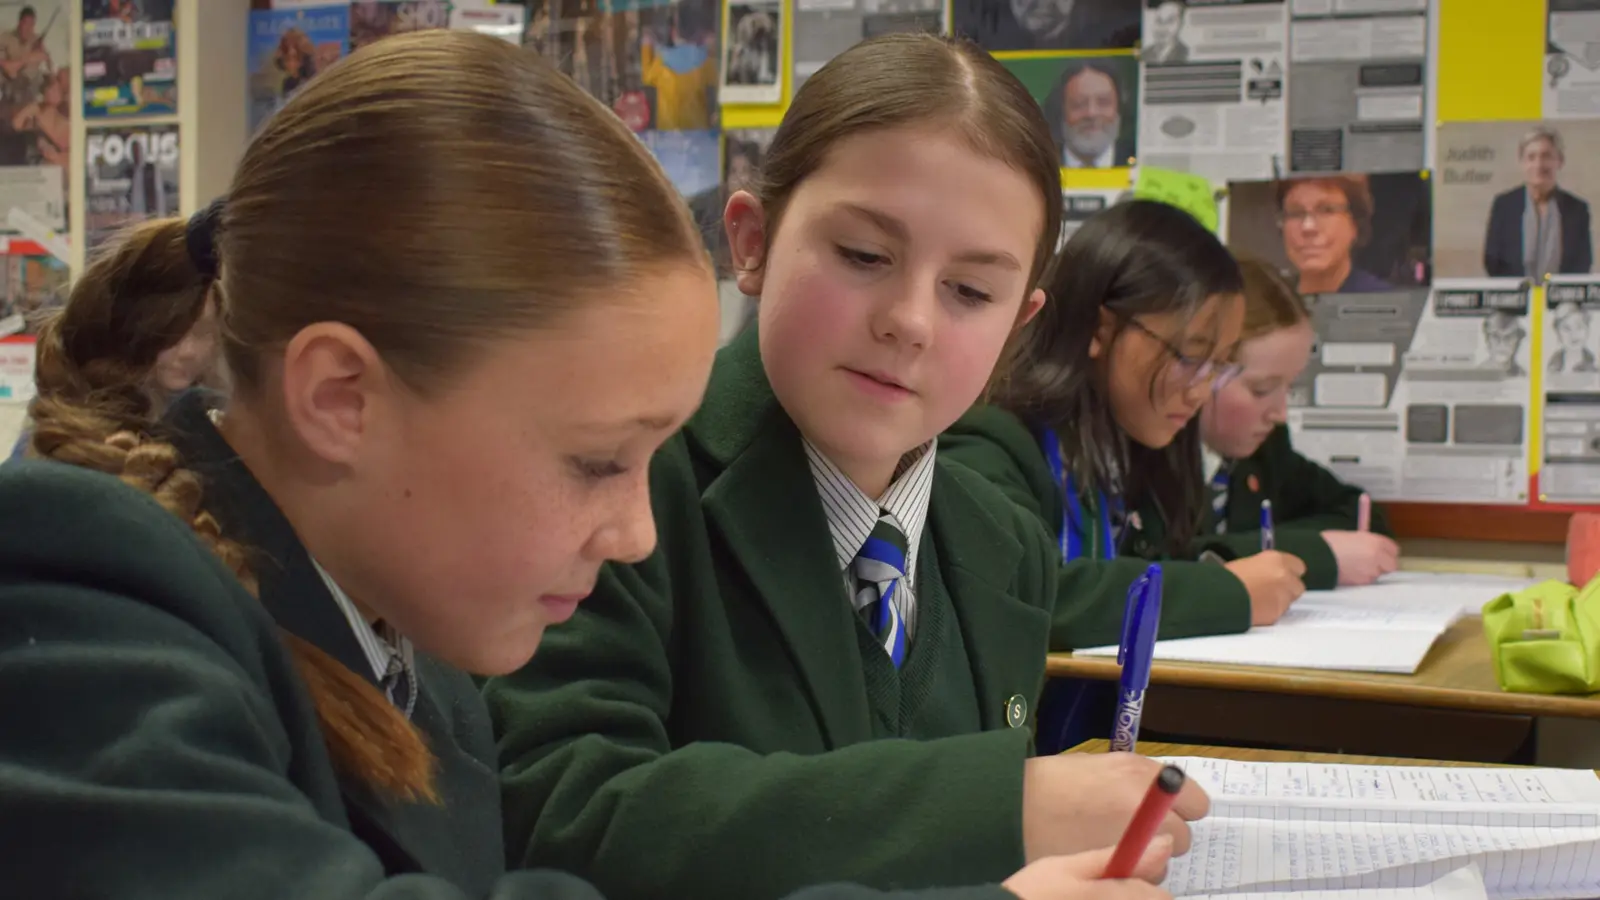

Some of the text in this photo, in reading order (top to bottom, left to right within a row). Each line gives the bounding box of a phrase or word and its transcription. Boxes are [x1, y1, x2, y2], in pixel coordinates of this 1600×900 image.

[87, 132, 179, 168] FOCUS
[1444, 146, 1496, 162] Judith
[1013, 703, 1022, 719] S
